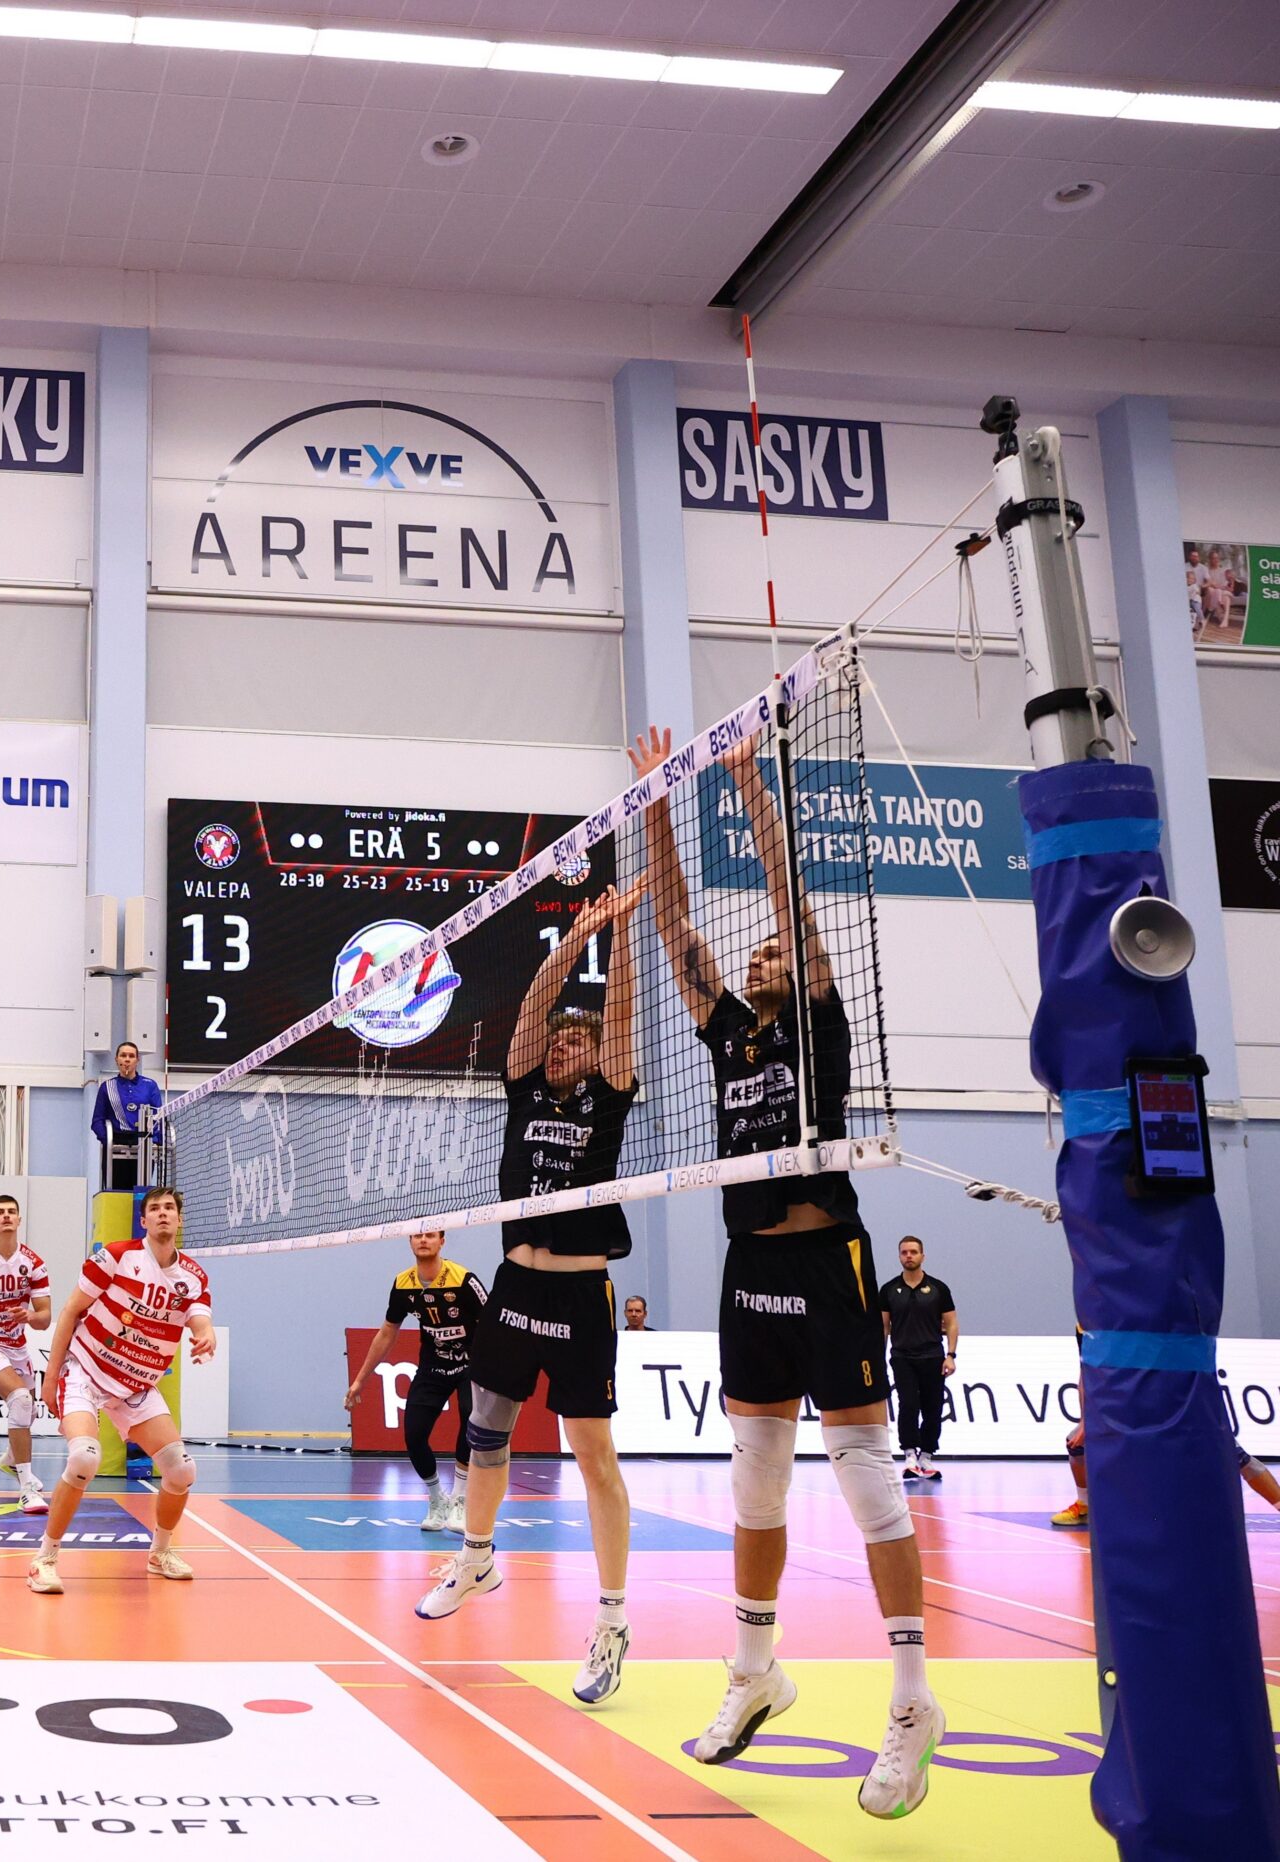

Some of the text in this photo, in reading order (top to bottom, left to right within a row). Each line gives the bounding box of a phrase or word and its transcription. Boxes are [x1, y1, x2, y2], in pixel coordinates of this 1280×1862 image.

[303, 444, 464, 489] VEXVE
[682, 416, 875, 510] SASKY
[190, 511, 577, 595] AREENA
[345, 809, 446, 823] Powered by jidoka.fi
[880, 796, 984, 829] TAHTOO
[349, 826, 441, 860] ERÄ 5
[399, 948, 416, 971] BEWI
[420, 934, 437, 958] BEWI
[441, 919, 459, 944] BEWI
[463, 903, 483, 928] BEWI
[488, 882, 509, 910] BEWI
[516, 861, 538, 892] BEWI
[552, 831, 577, 866] BEWI
[585, 806, 612, 844] BEWI
[623, 776, 652, 817] BEWI
[663, 745, 696, 787] BEWI
[709, 711, 744, 757] BEWI
[869, 834, 983, 869] PARASTA
[184, 880, 251, 899] VALEPA
[280, 872, 325, 887] 28-30
[343, 875, 387, 890] 25-23
[405, 877, 449, 892] 25-19
[467, 880, 501, 893] 17-
[181, 913, 251, 972] 13
[205, 995, 228, 1039] 2
[748, 1109, 788, 1130] AKELA
[673, 1167, 705, 1188] VEXVE
[706, 1165, 721, 1183] OY
[0, 1274, 16, 1292] 10
[145, 1282, 167, 1310] 16
[426, 1306, 441, 1324] 17
[499, 1307, 571, 1339] FYSIO MAKER
[149, 1372, 159, 1381] OY
[861, 1359, 873, 1387] 8
